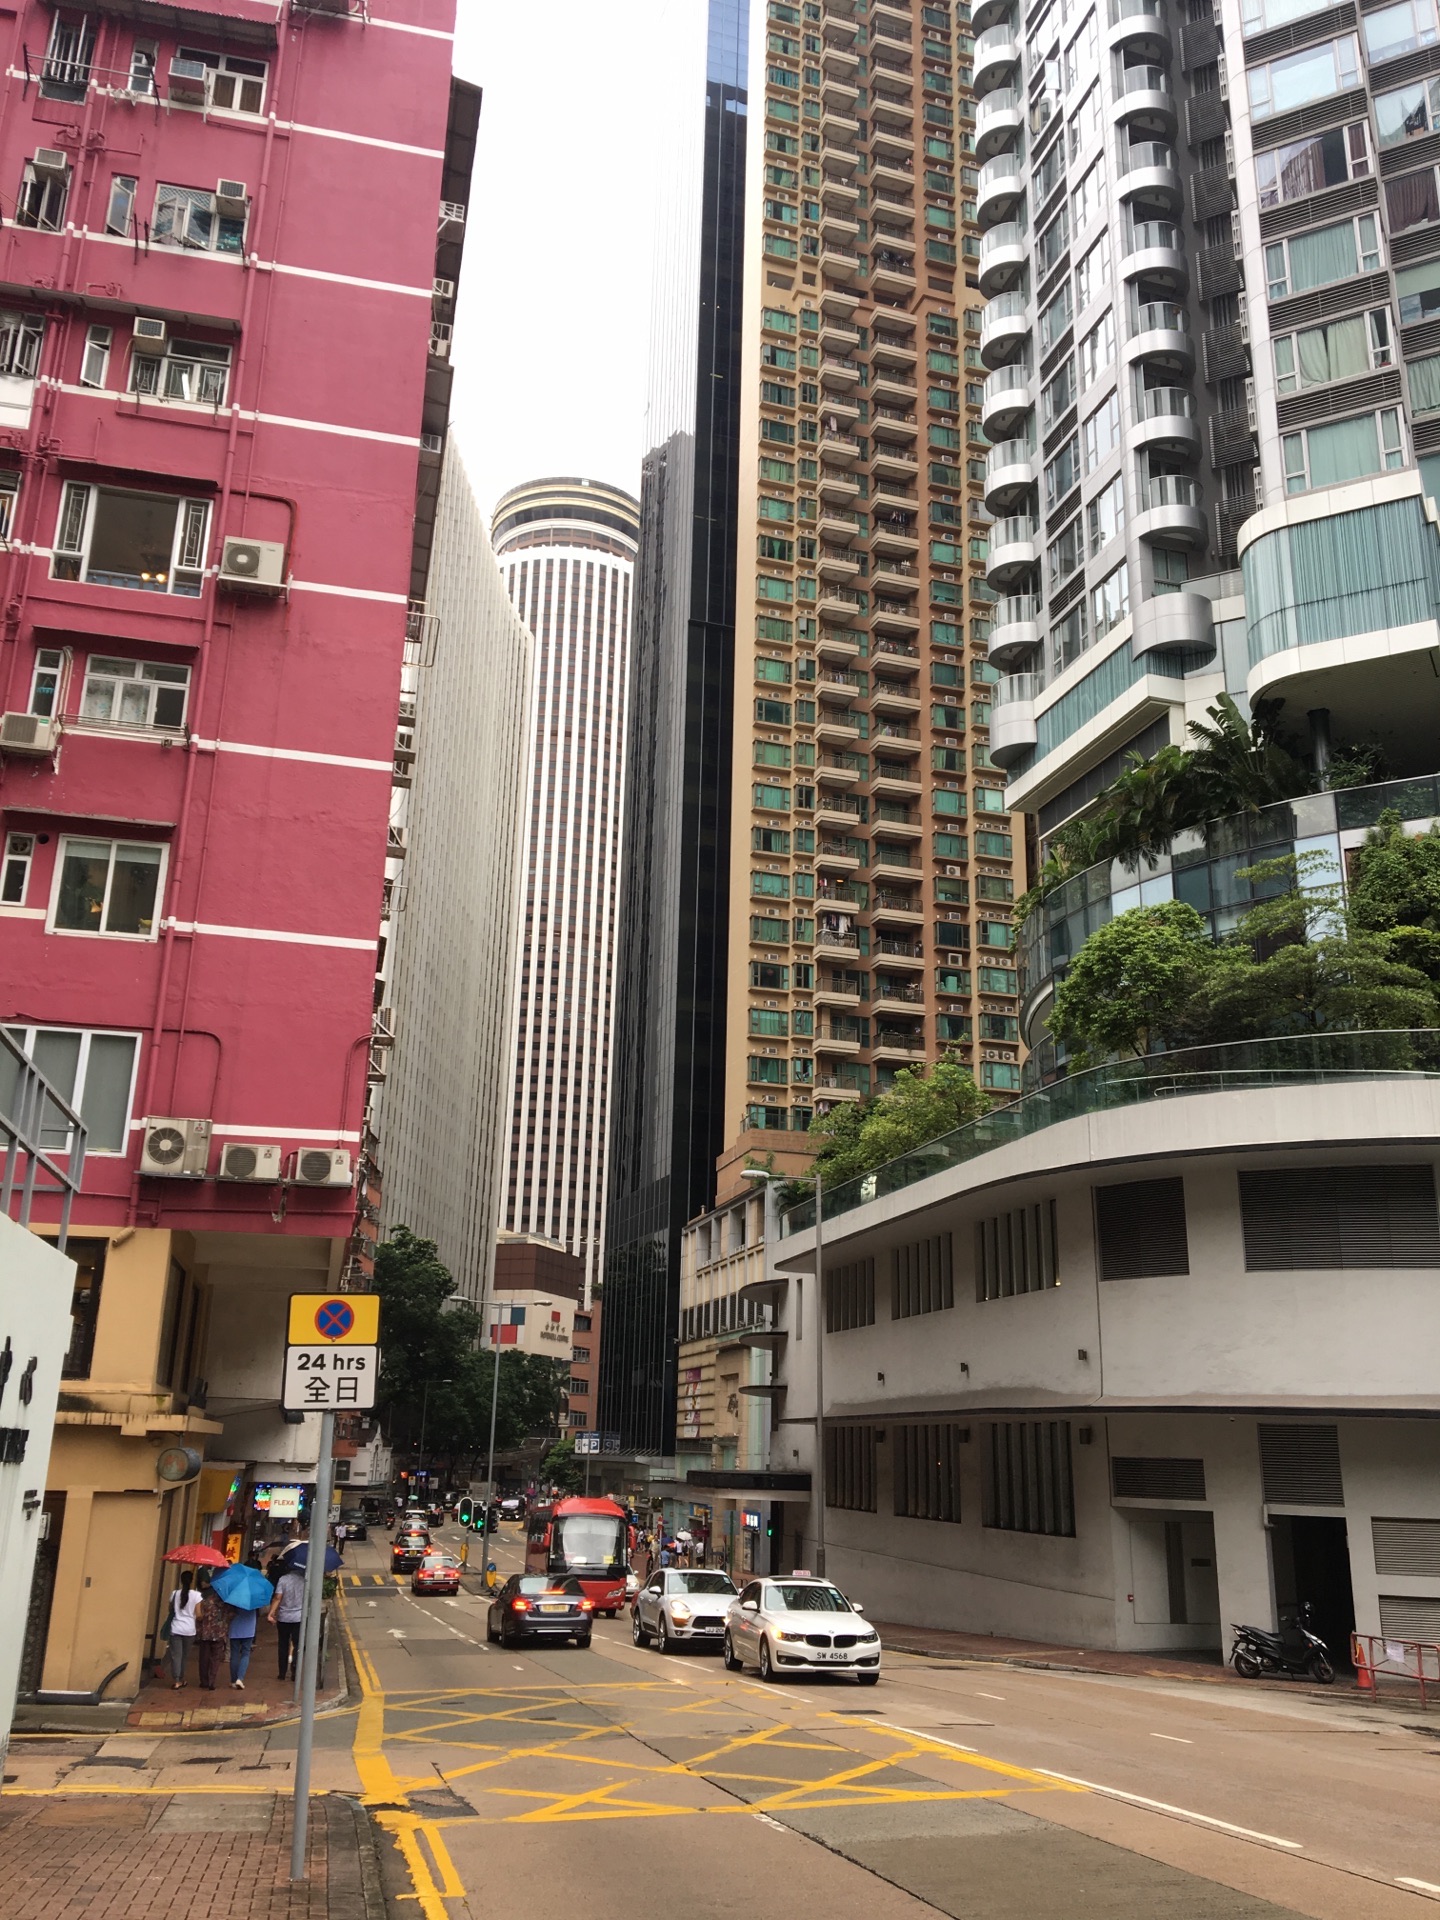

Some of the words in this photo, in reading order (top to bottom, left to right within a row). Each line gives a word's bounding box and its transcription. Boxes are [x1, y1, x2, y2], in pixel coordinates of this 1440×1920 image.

[297, 1353, 327, 1371] 24
[333, 1353, 366, 1371] hrs
[304, 1376, 359, 1403] 全日
[816, 1651, 828, 1660] SW
[829, 1652, 848, 1660] 4568
